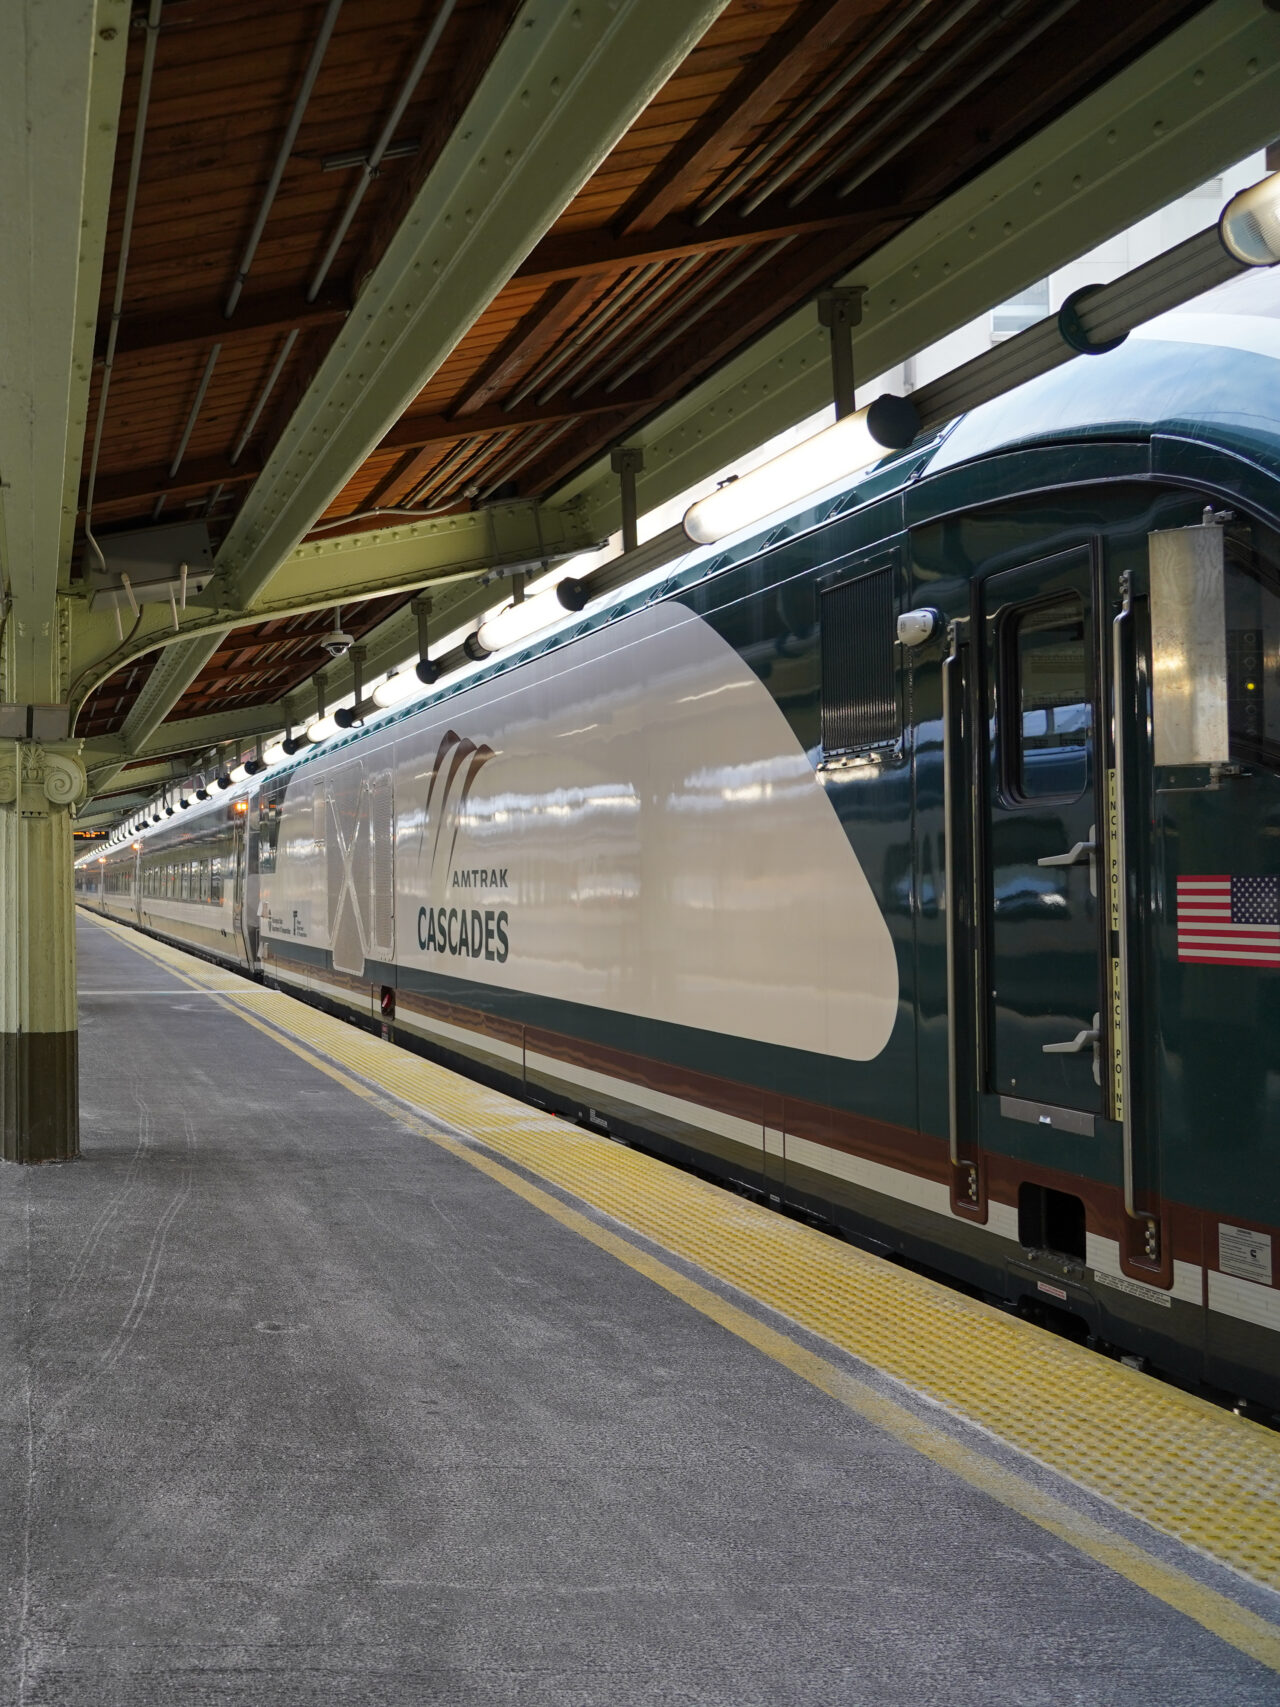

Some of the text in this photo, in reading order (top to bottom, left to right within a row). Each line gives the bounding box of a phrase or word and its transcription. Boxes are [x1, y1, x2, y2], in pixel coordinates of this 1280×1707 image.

[452, 868, 508, 888] AMTRAK
[1109, 771, 1119, 928] PINCH POINT
[417, 906, 509, 964] CASCADES
[1115, 1049, 1123, 1118] POINT
